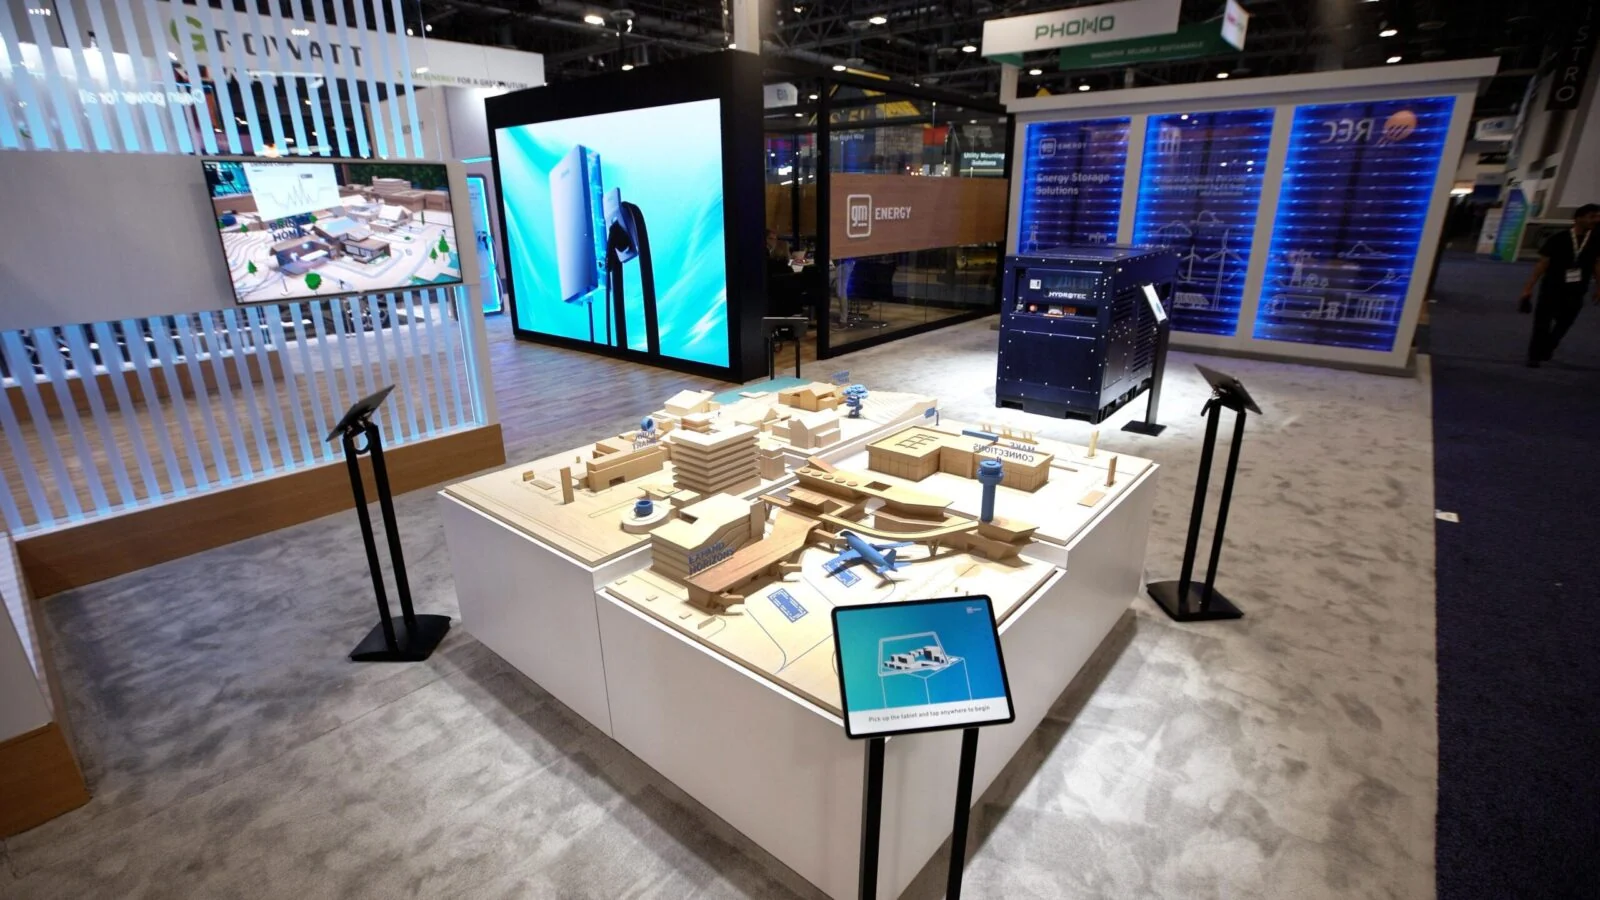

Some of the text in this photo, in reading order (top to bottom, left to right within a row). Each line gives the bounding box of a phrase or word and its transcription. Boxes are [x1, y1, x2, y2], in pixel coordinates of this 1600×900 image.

[1037, 173, 1110, 184] Energy Storage
[1035, 185, 1079, 195] Solutions
[875, 206, 912, 220] ENERGY
[868, 715, 881, 723] Pick
[901, 711, 918, 719] tablet
[930, 710, 940, 718] tap
[940, 707, 967, 716] anywhere
[975, 704, 990, 713] begin
